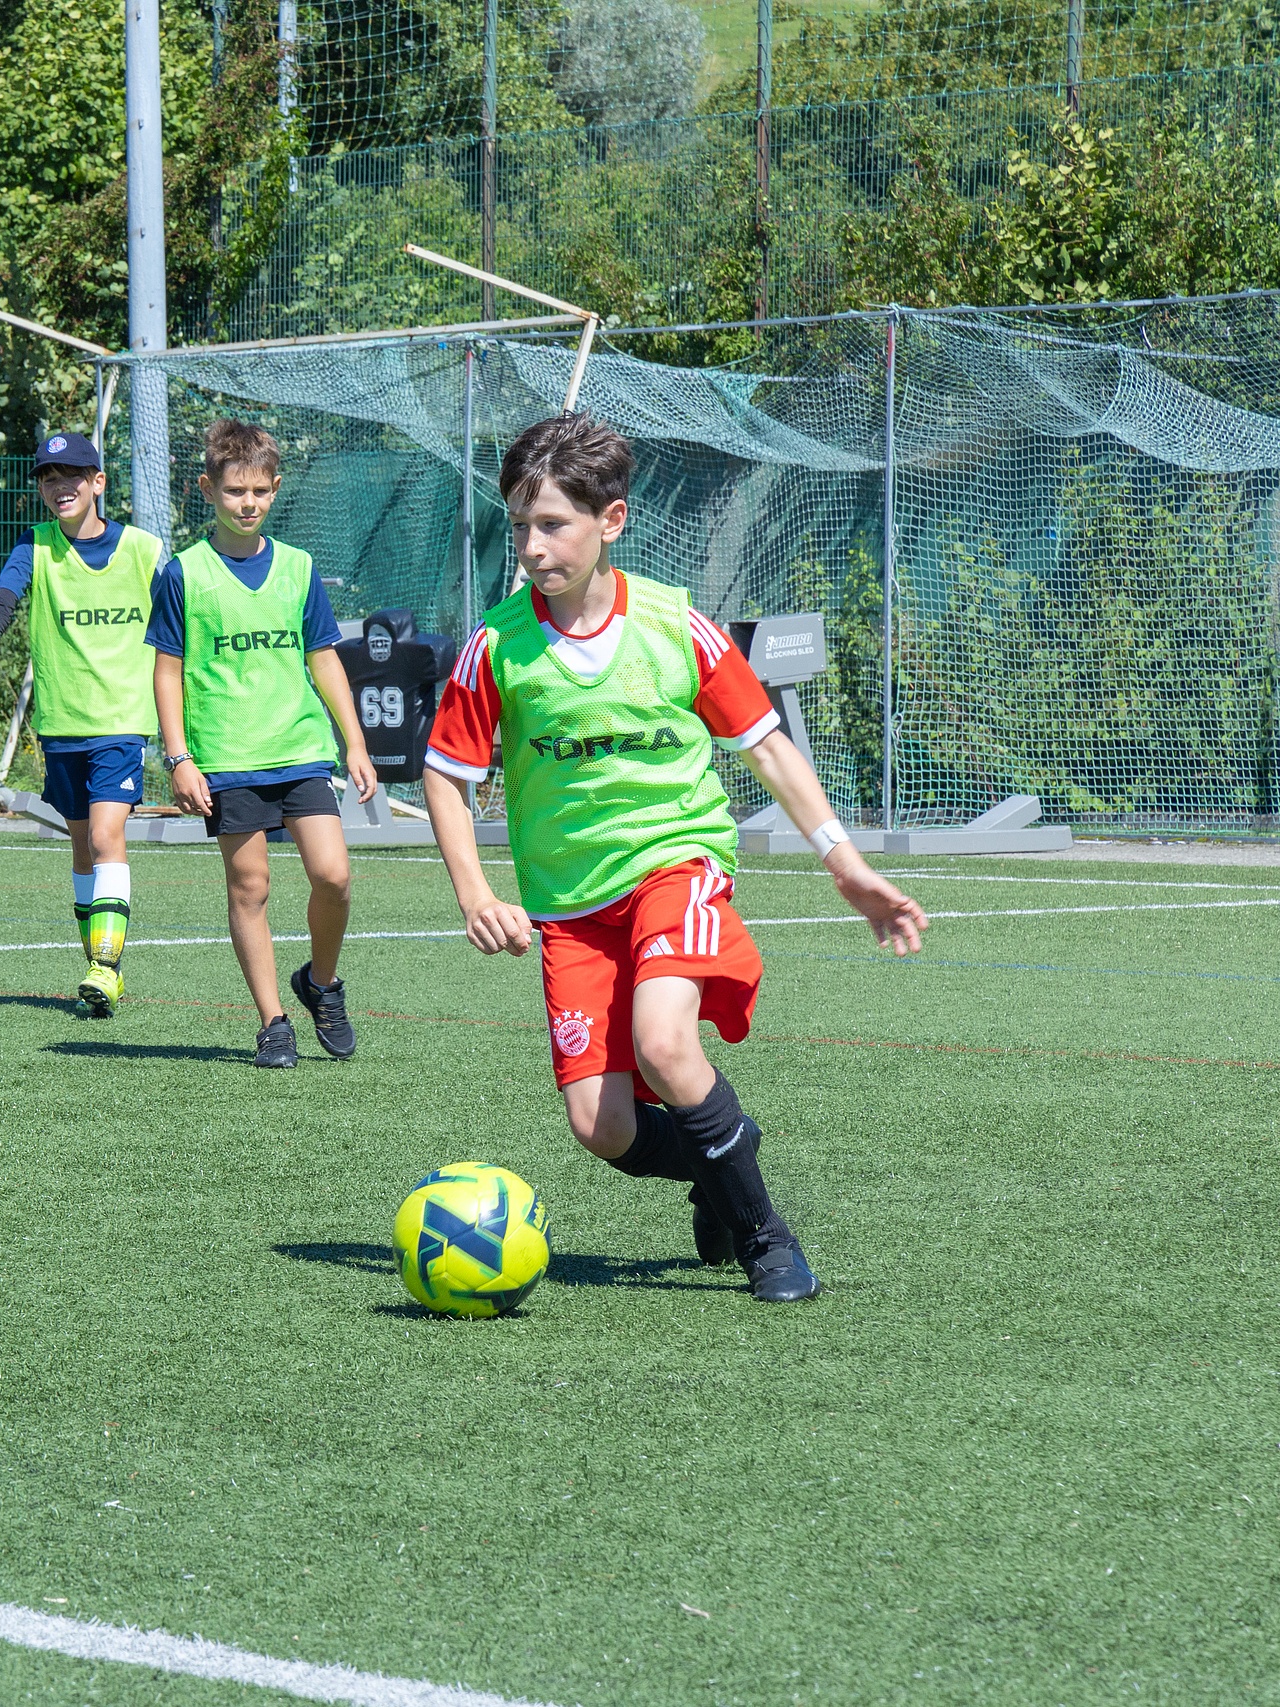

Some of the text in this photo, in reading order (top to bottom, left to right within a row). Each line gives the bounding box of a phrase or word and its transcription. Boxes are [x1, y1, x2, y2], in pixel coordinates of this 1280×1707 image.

[60, 607, 144, 627] FORZA
[214, 629, 301, 655] FORZA
[766, 646, 814, 659] BLOCKING SLED
[773, 633, 813, 649] JAMBO
[360, 686, 404, 728] 69
[529, 727, 684, 761] FORZA
